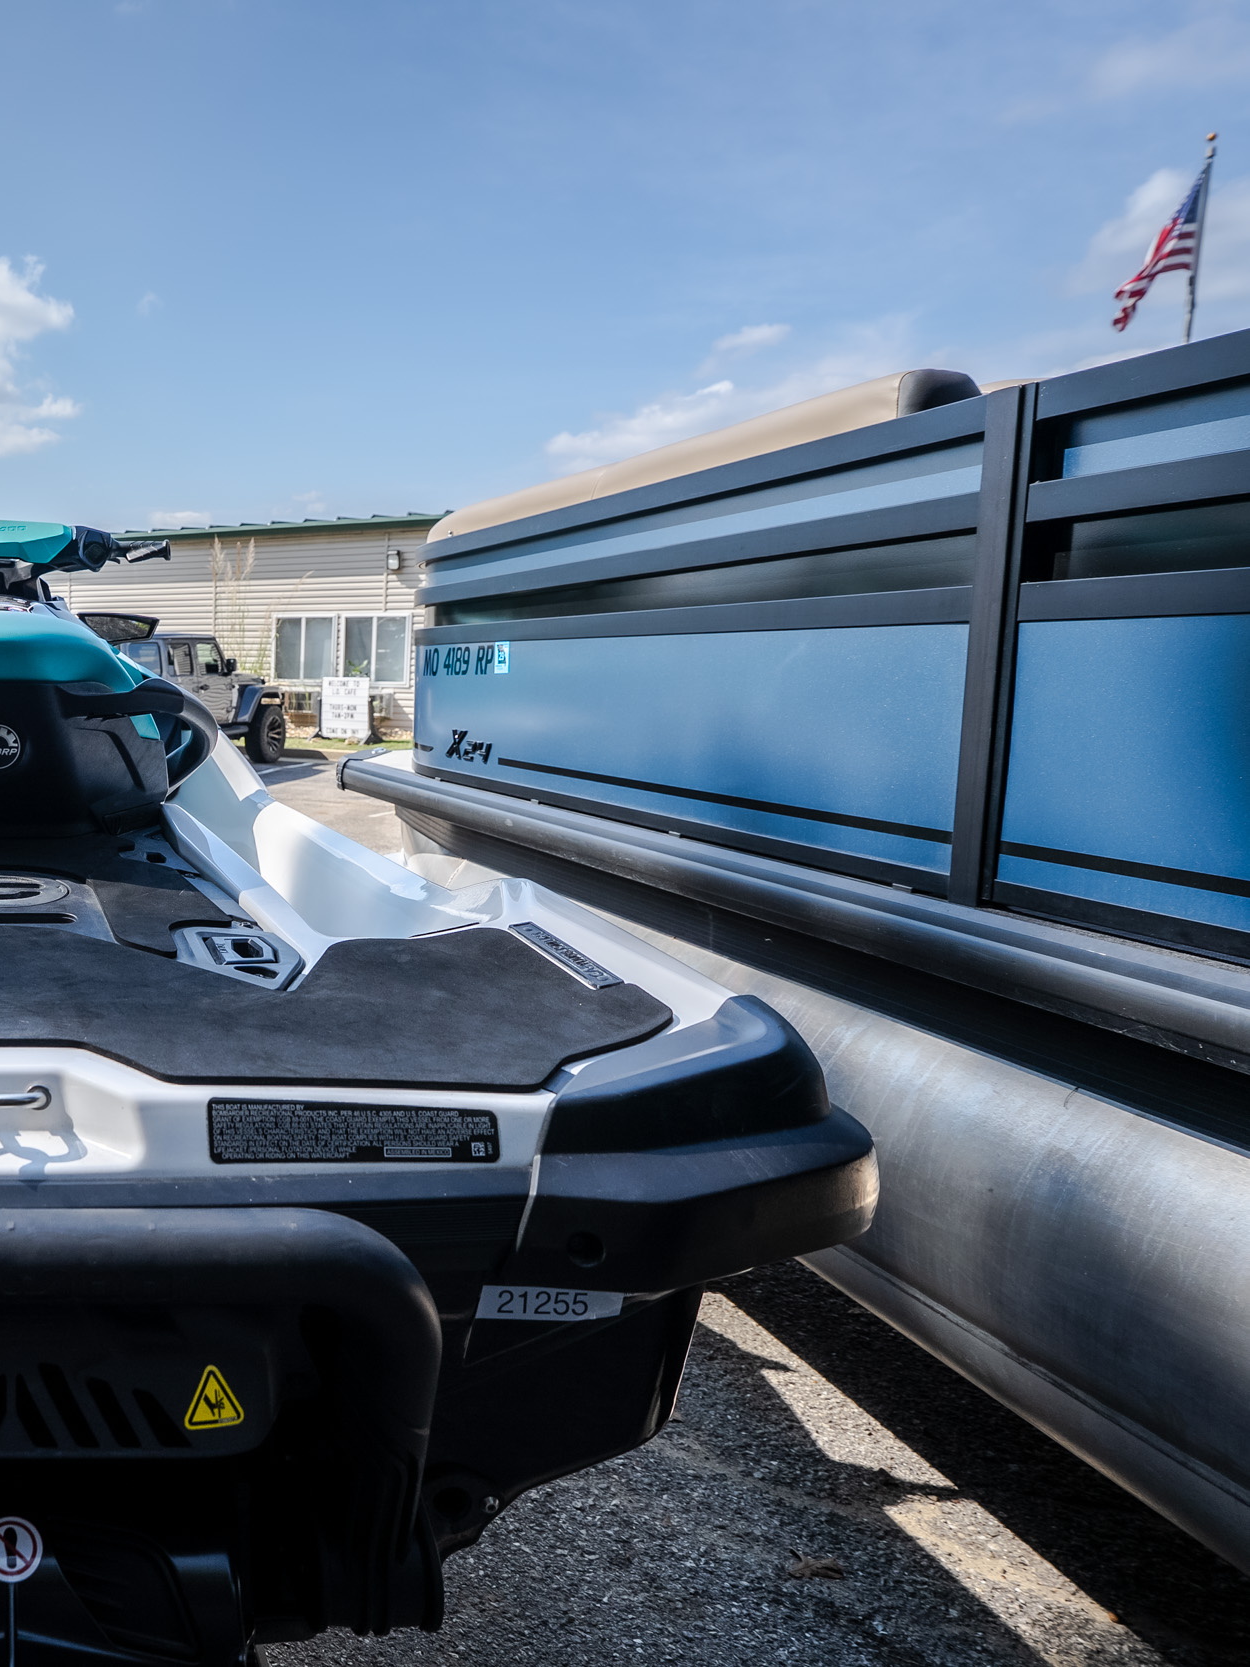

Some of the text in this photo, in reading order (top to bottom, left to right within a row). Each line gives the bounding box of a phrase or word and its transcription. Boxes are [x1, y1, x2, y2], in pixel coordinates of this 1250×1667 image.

[423, 645, 494, 676] MO 4189 RP
[445, 729, 492, 764] X24
[497, 1290, 588, 1316] 21255
